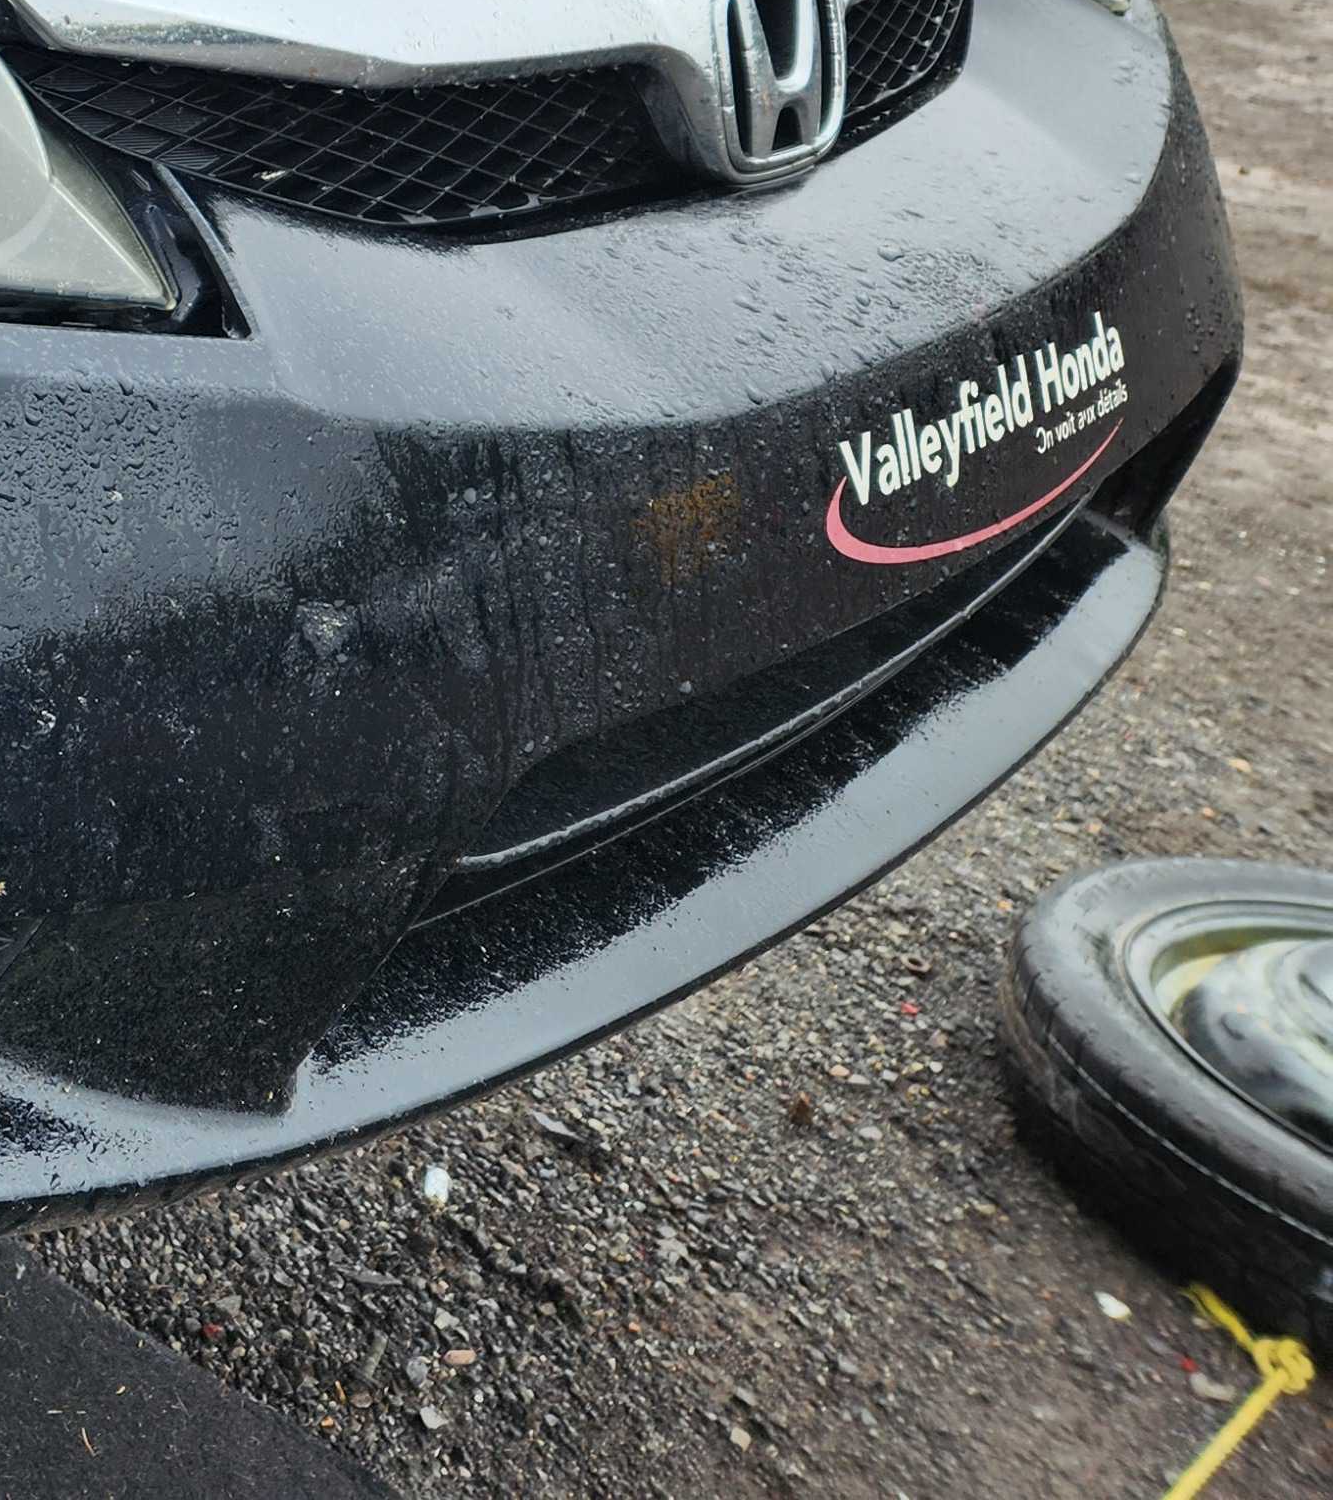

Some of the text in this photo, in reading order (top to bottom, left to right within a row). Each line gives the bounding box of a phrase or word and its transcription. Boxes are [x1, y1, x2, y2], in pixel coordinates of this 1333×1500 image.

[838, 311, 1125, 506] Valleyfield Honda
[1055, 411, 1077, 442] voit
